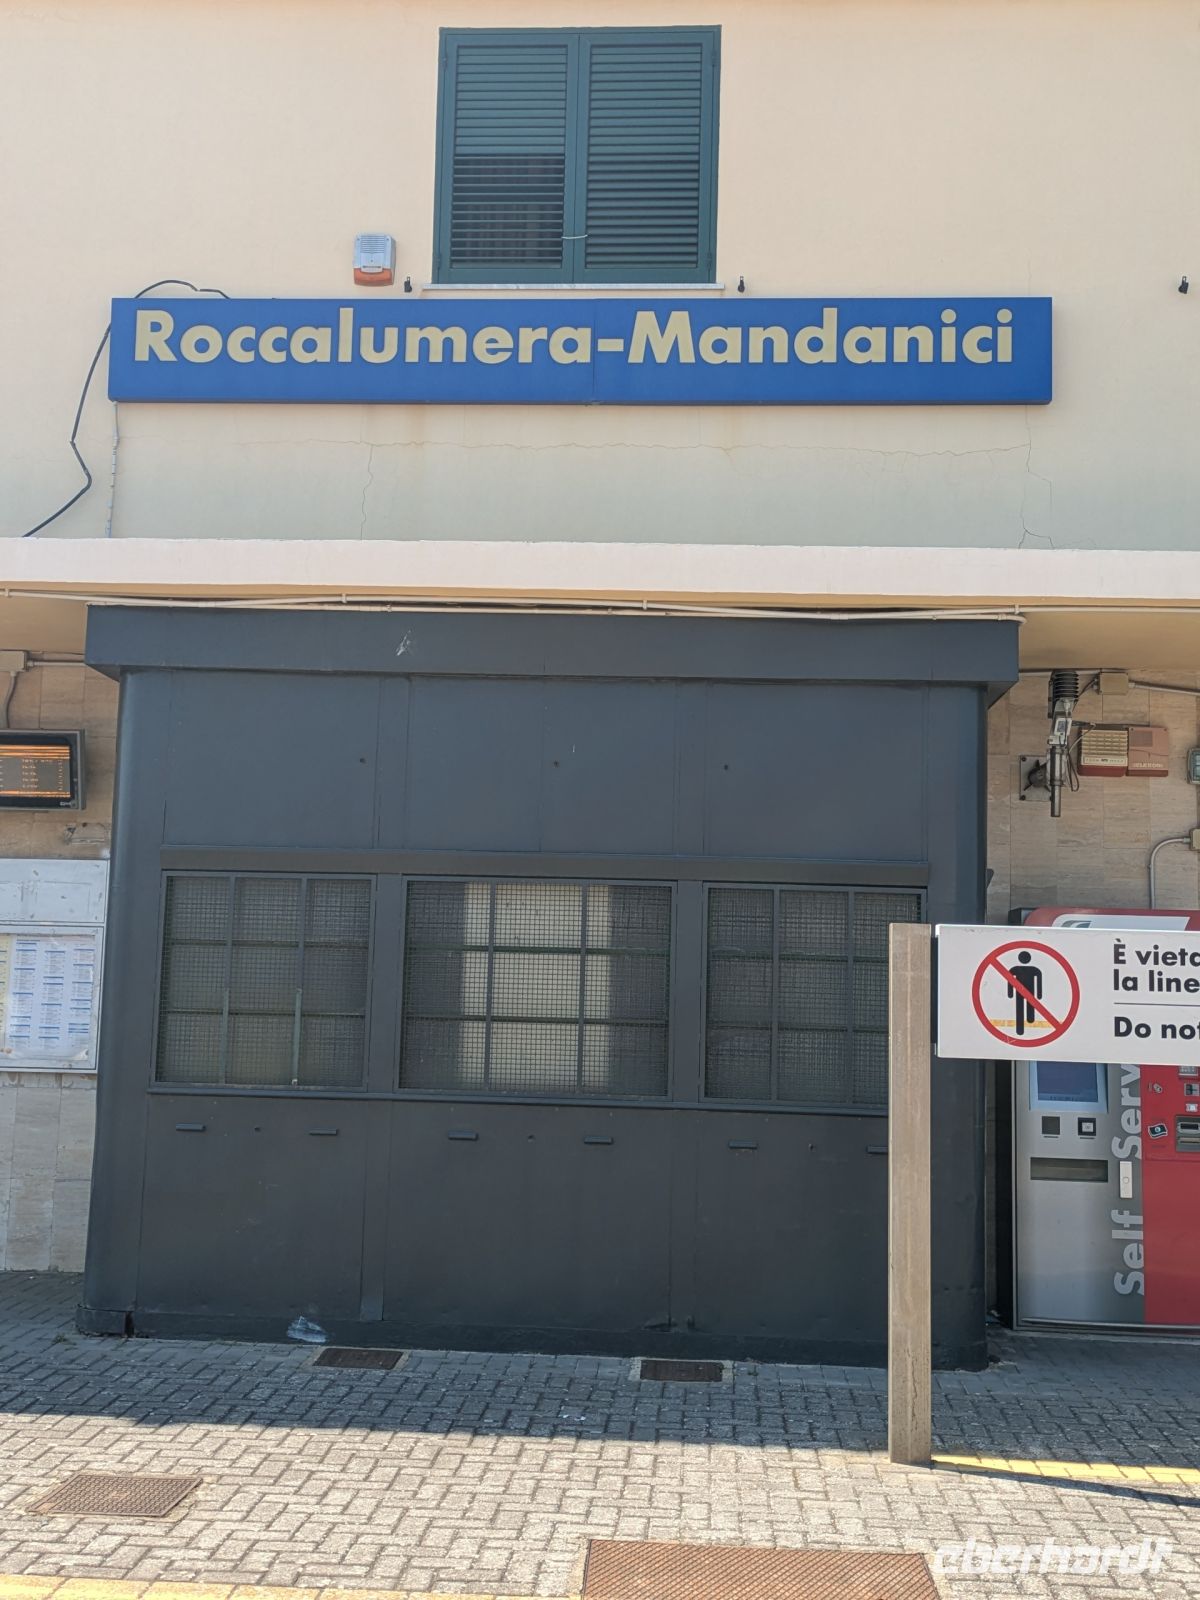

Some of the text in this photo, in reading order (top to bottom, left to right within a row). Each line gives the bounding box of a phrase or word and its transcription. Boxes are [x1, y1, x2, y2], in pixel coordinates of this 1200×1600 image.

[133, 307, 1014, 364] Roccalumera-Mandanici
[1113, 938, 1126, 965] È
[1113, 968, 1138, 991] la
[1114, 1016, 1152, 1039] Do
[1111, 1209, 1145, 1296] Self
